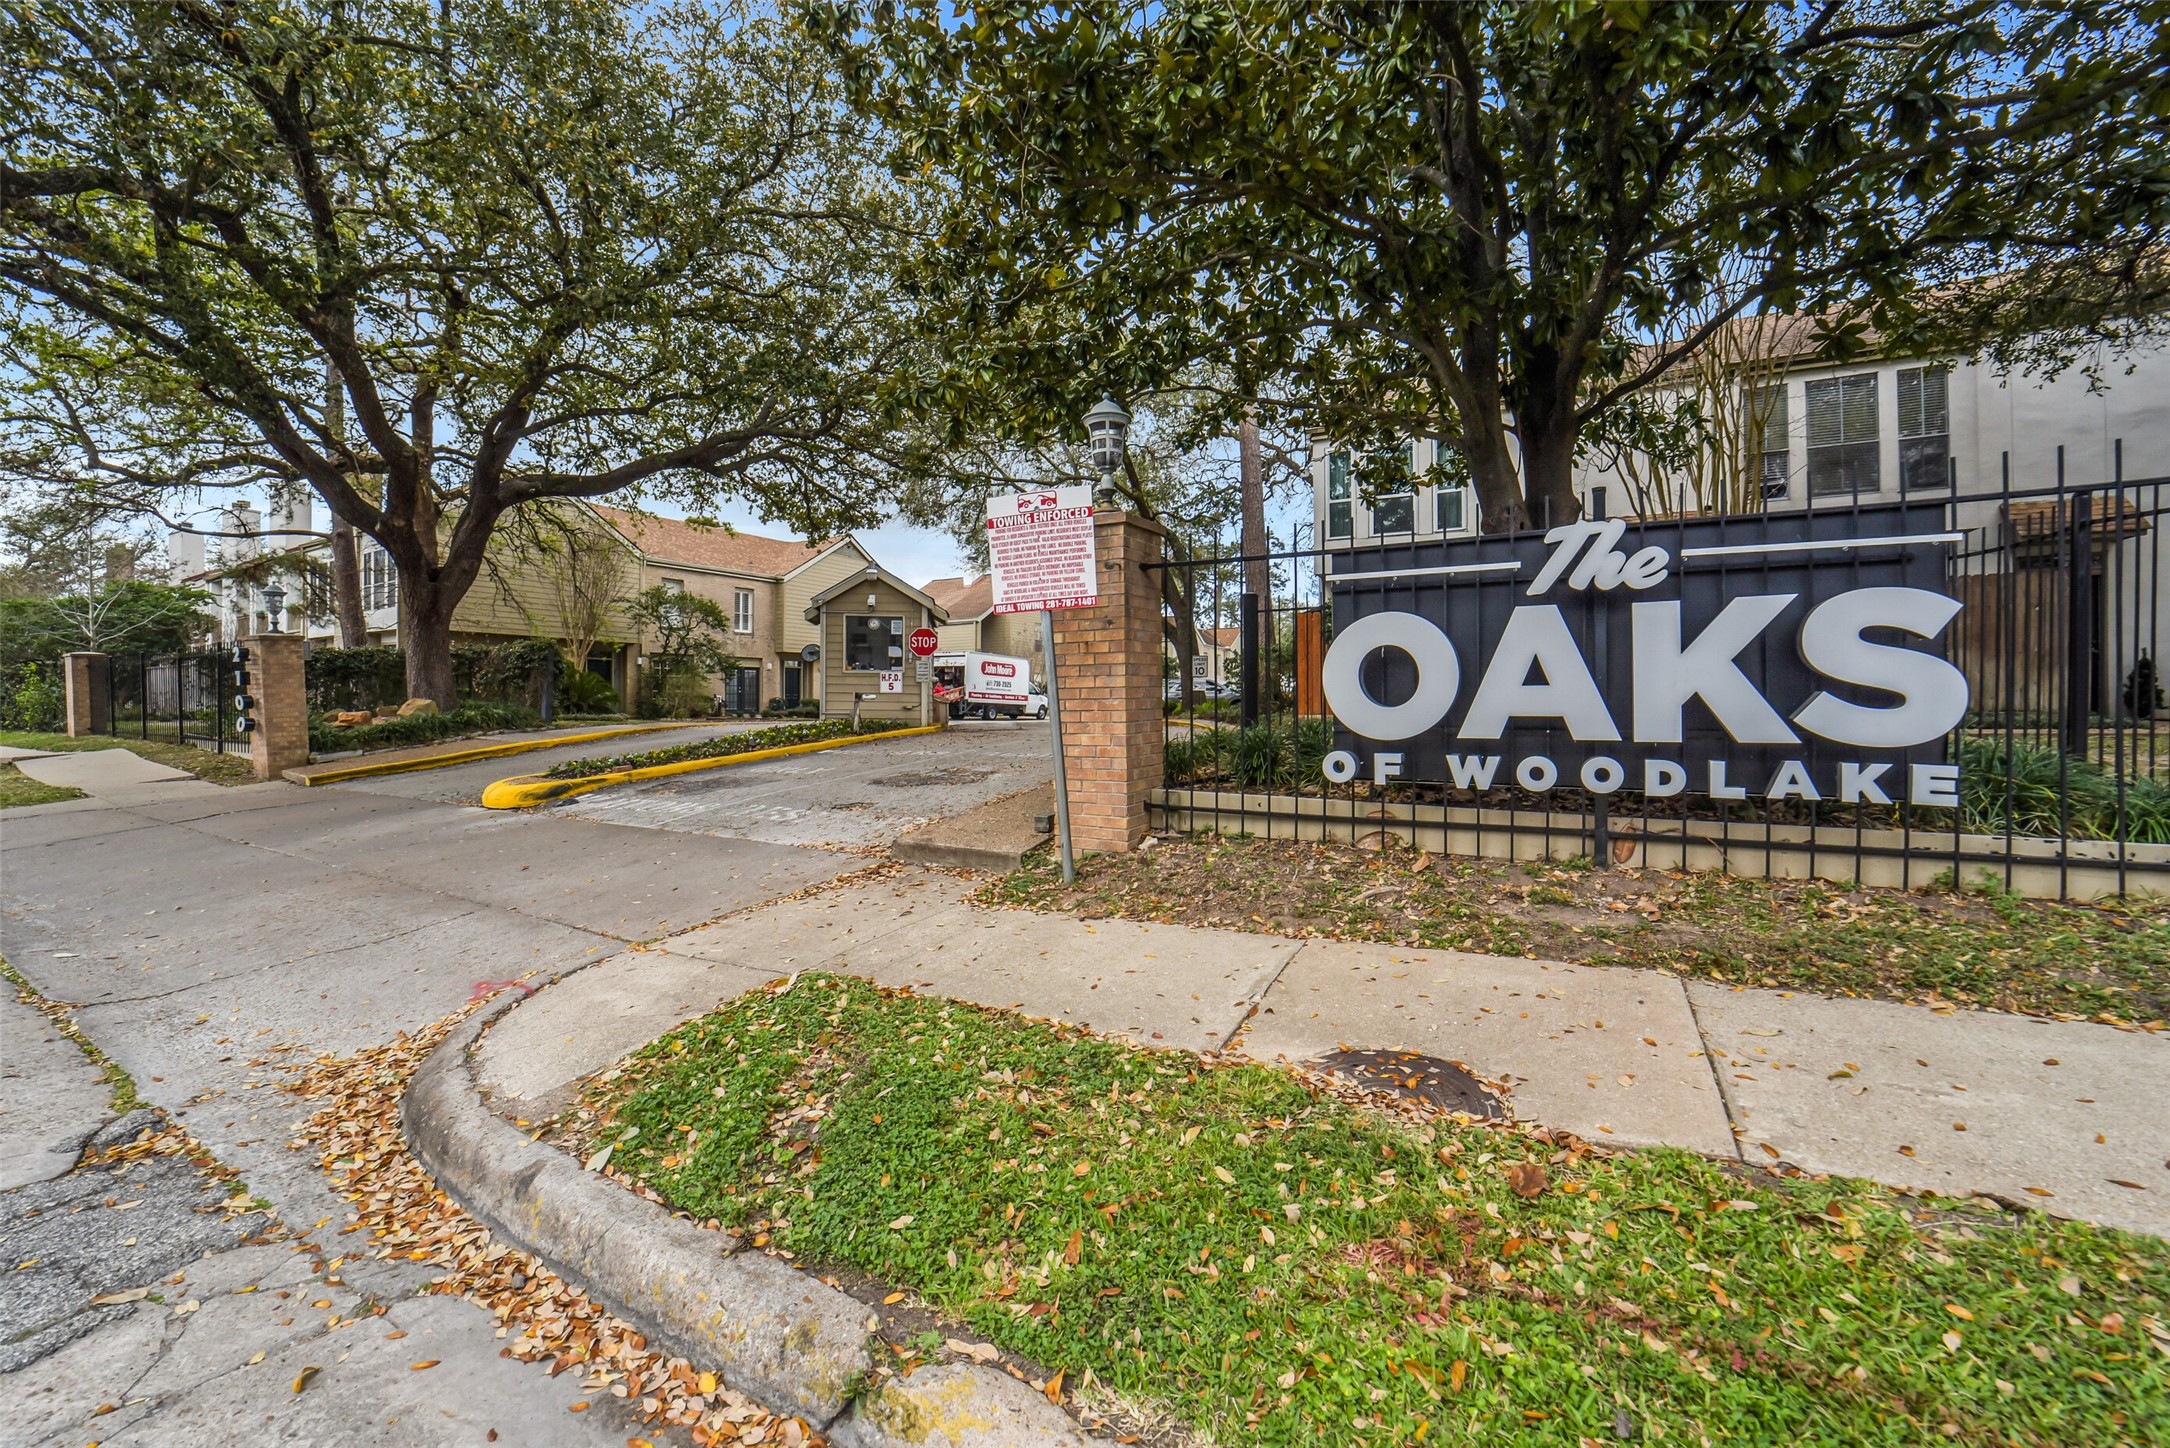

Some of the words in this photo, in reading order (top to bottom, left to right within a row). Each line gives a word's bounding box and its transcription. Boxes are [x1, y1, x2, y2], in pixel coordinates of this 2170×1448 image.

[992, 514, 1031, 528] TOWING
[1034, 507, 1088, 523] ENFORCED
[1526, 519, 1669, 597] The
[996, 603, 1015, 612] IDEAL
[1017, 601, 1044, 610] TOWING
[1046, 596, 1095, 608] 281-787-1401
[911, 636, 936, 648] STOP
[984, 664, 997, 674] John
[997, 664, 1012, 676] Moore
[1322, 586, 1969, 749] OAKS
[881, 674, 901, 682] H.F.D.
[1322, 750, 1404, 786] OF
[1445, 754, 1960, 808] WOODLAKE
